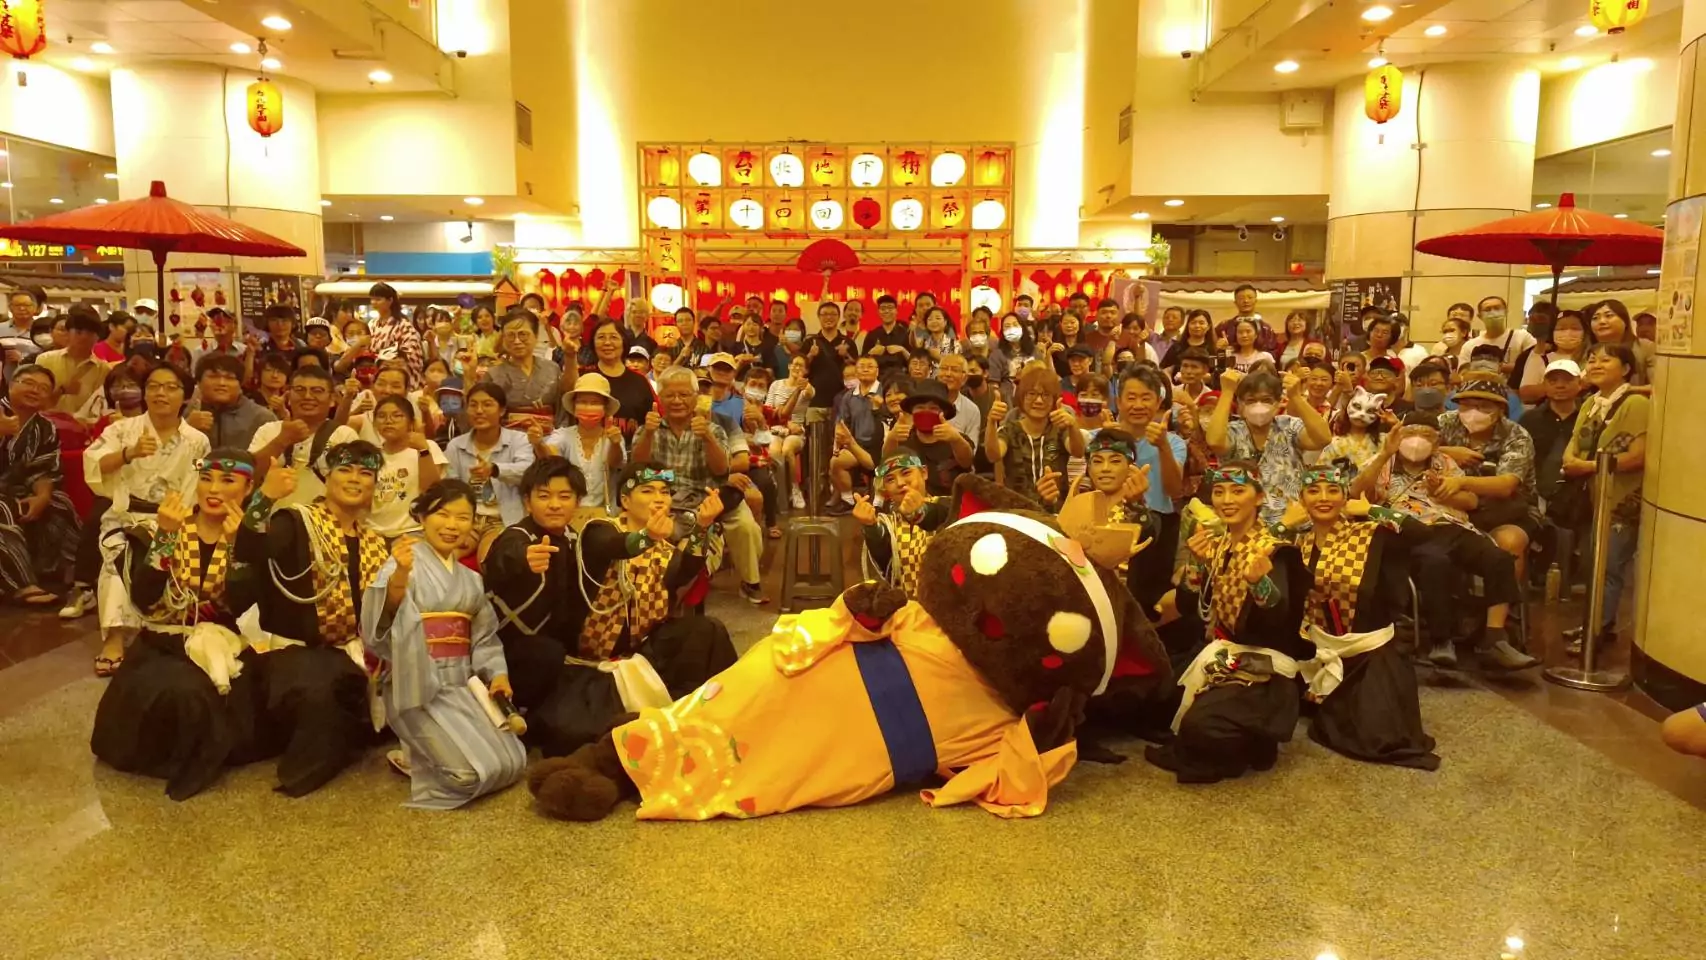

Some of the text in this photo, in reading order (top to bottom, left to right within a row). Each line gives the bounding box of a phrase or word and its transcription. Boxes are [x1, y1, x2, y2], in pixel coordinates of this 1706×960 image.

[735, 156, 921, 178] 台北地下街
